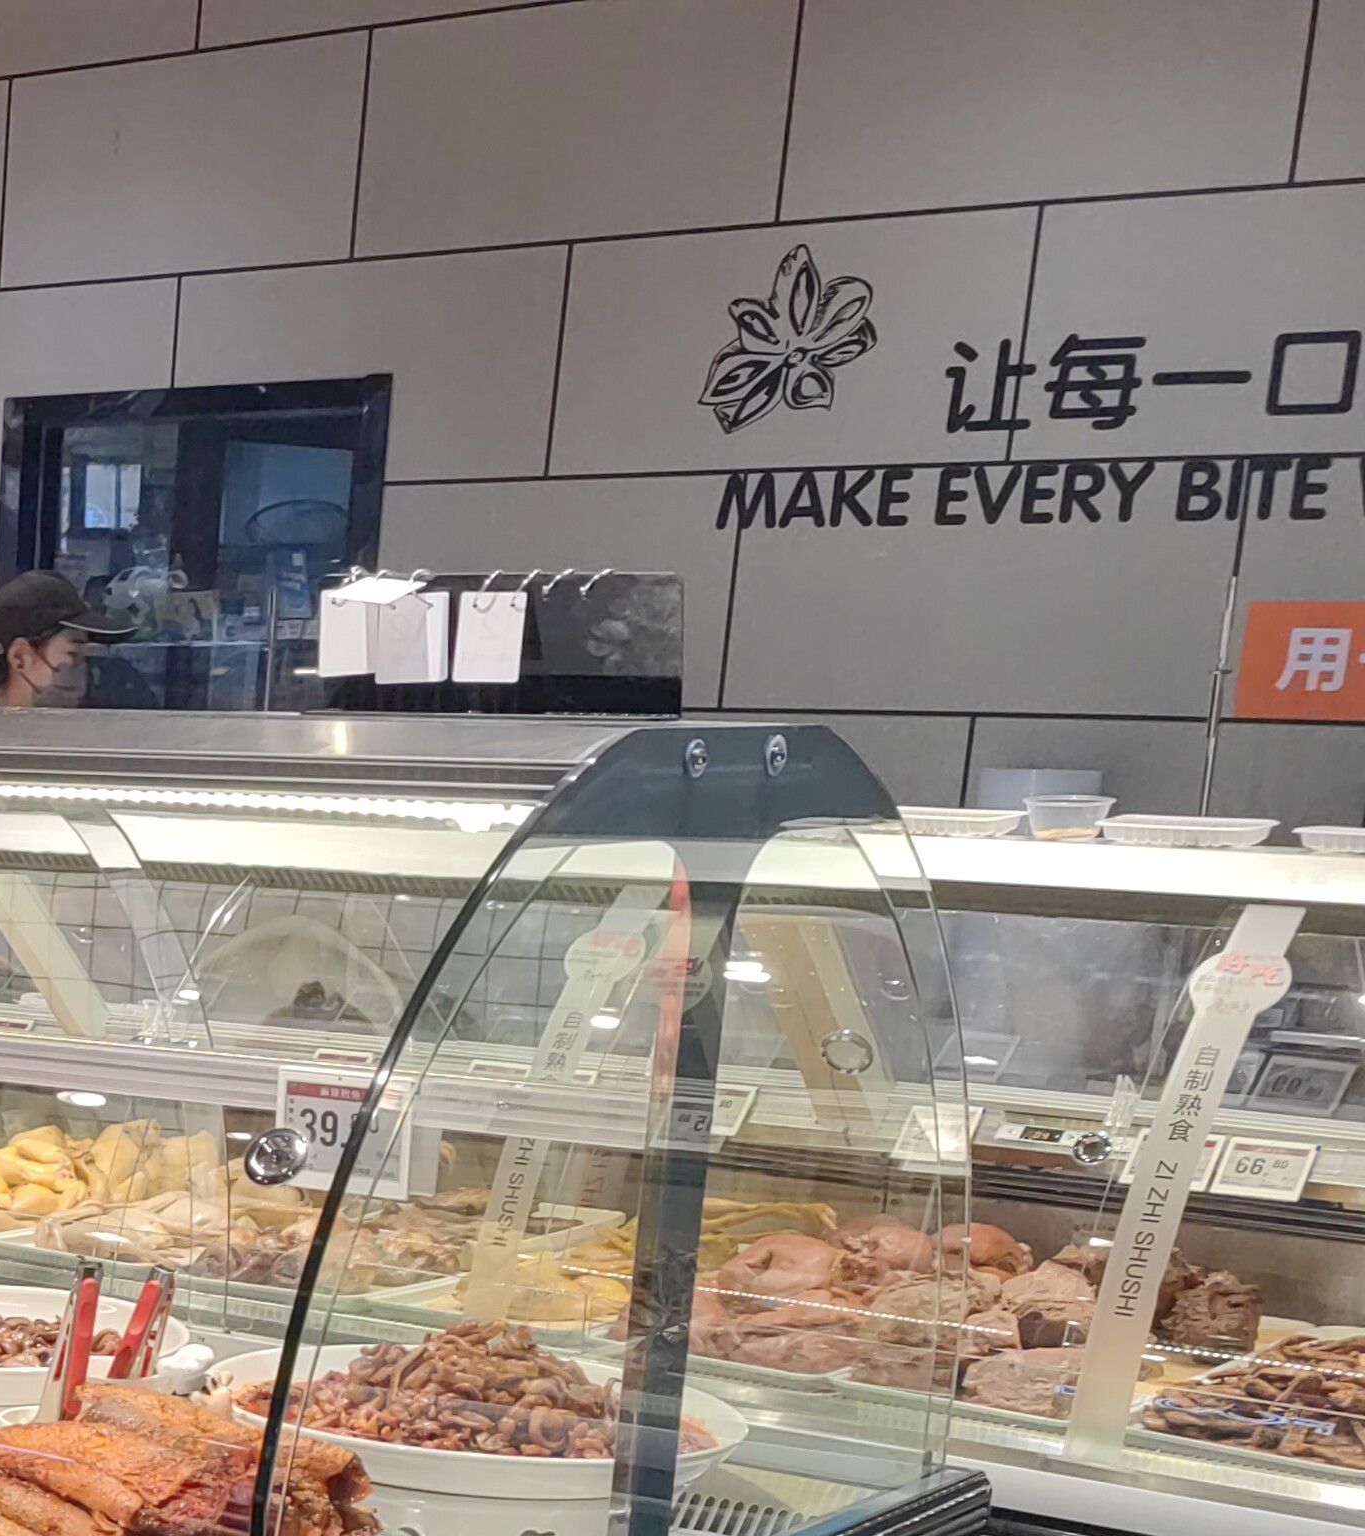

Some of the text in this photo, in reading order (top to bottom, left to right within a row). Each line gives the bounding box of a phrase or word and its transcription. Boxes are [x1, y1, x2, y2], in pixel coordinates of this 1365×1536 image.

[946, 330, 1362, 433] 让每一口
[715, 455, 1332, 530] MAKE EVERY BITE
[1274, 627, 1365, 692] 用
[1167, 1045, 1221, 1143] 自制熟食
[1114, 1159, 1178, 1319] ZI ZHI SHUSHI
